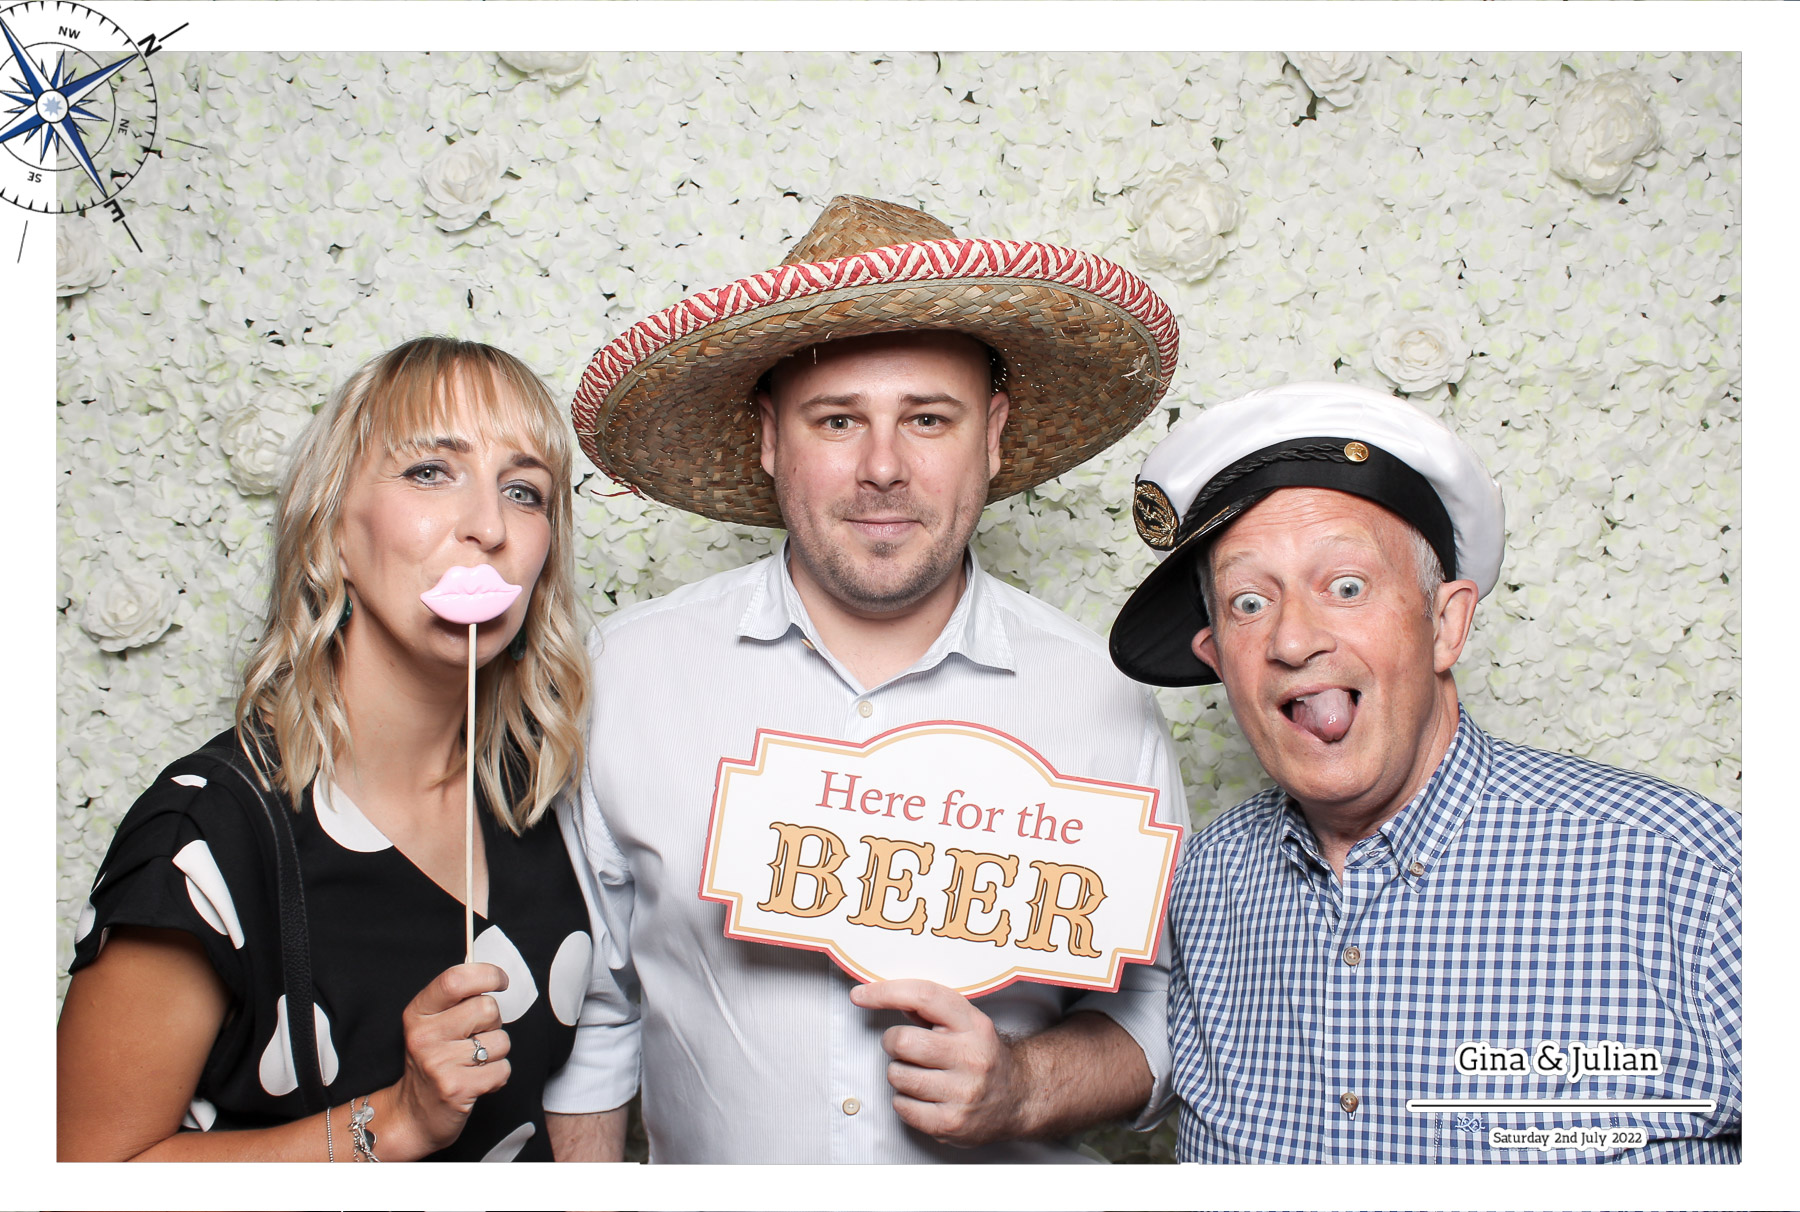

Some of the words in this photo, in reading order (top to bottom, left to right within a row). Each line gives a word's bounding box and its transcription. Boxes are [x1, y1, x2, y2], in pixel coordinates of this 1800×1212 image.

[815, 769, 927, 822] Here
[938, 789, 1005, 834] for
[1016, 802, 1084, 845] the
[757, 821, 1109, 959] BEER
